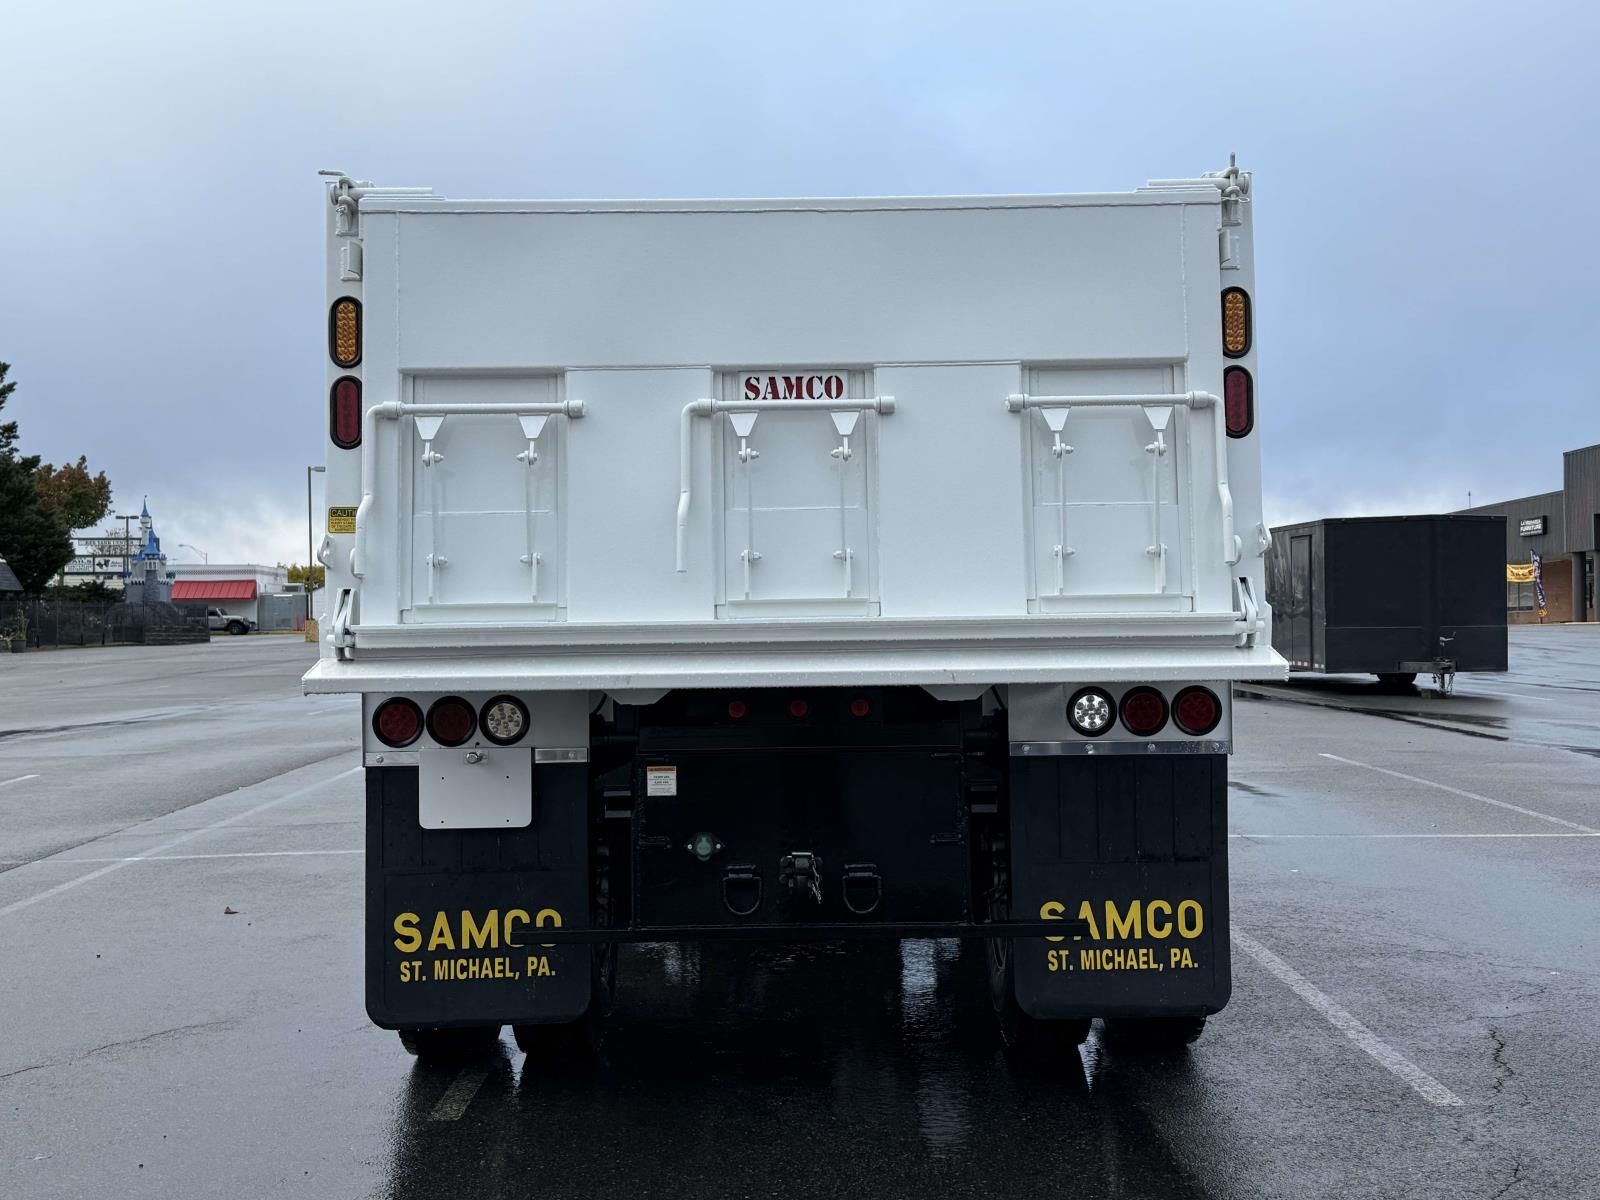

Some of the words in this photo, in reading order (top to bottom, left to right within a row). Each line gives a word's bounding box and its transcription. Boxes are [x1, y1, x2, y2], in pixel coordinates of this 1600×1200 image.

[744, 375, 843, 400] SAMCO
[332, 509, 356, 517] CAUTI
[393, 908, 562, 953] SAMCO
[1039, 899, 1204, 942] SAMCO
[400, 960, 427, 983] ST.
[434, 956, 520, 981] MICHAEL,
[527, 956, 556, 977] PA.
[1047, 949, 1074, 972] ST.
[1080, 948, 1164, 972] MICHAEL,
[1170, 947, 1199, 969] PA.
